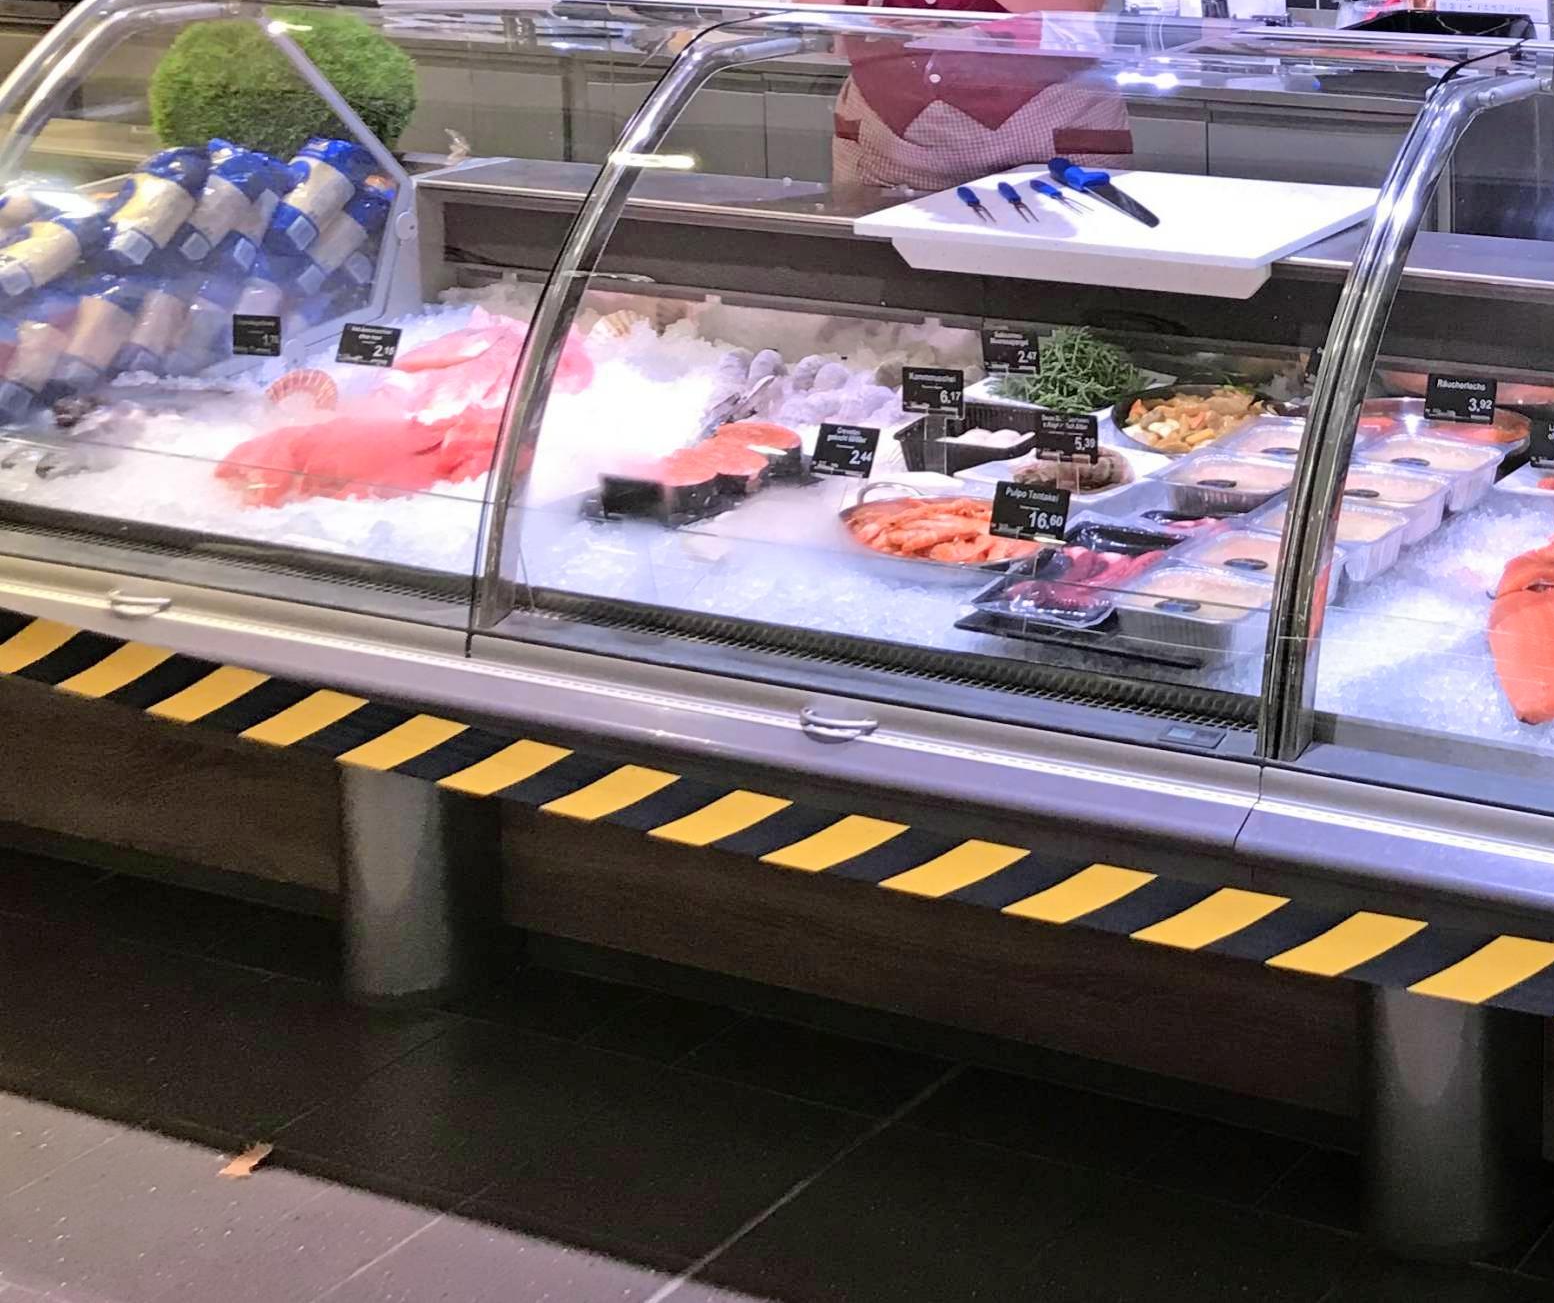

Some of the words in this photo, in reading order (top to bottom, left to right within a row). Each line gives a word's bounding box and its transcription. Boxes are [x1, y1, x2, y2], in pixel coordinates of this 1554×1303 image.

[1437, 379, 1486, 391] Räucherlachs
[940, 390, 961, 403] 6.17
[1468, 398, 1492, 412] 3.92
[1074, 437, 1095, 450] 5.39
[849, 450, 872, 465] 2.44
[1006, 487, 1026, 499] Pulpo
[1029, 511, 1063, 529] 16.60
